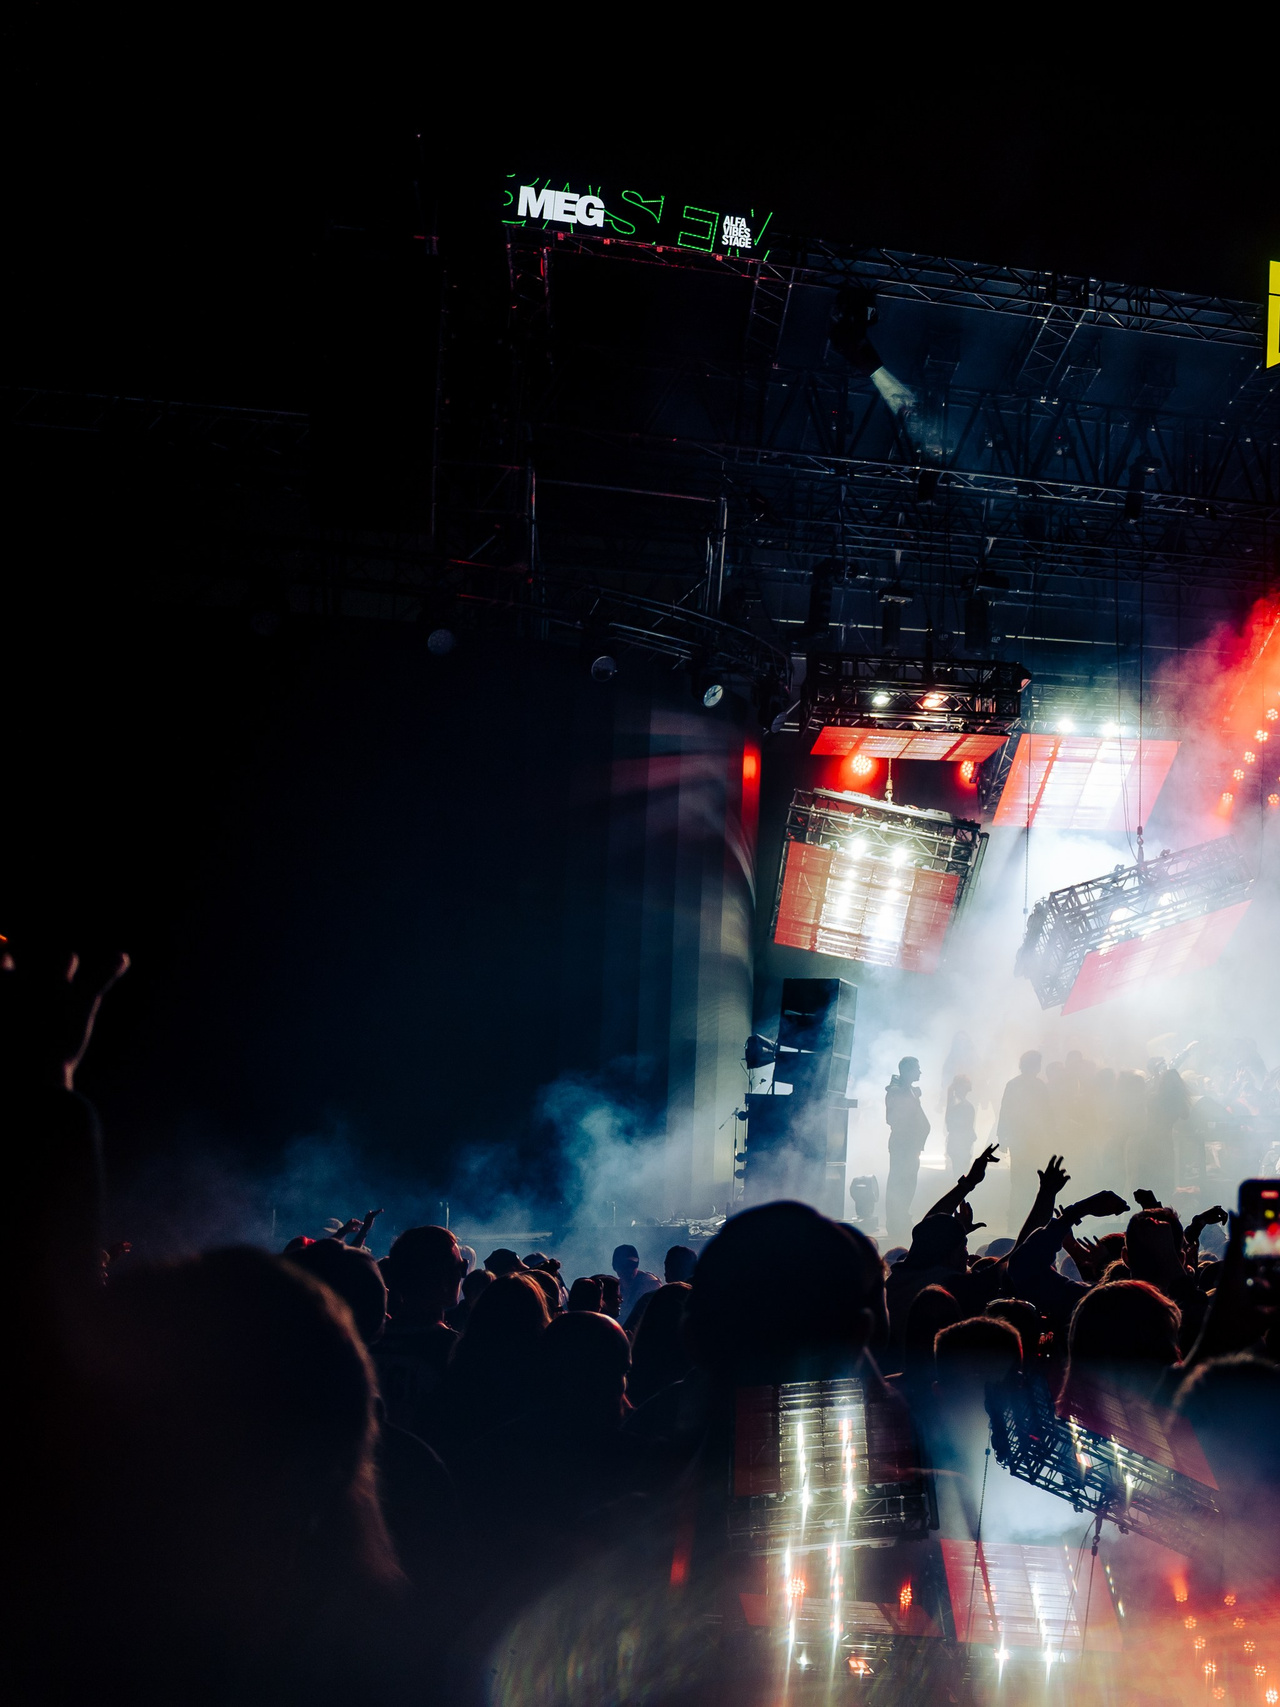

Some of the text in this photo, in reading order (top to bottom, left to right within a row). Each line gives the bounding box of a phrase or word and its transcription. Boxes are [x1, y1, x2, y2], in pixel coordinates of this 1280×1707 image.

[517, 185, 605, 228] MEG
[723, 215, 747, 229] ALFA
[723, 224, 751, 239] VIBES
[721, 234, 752, 249] STAGE
